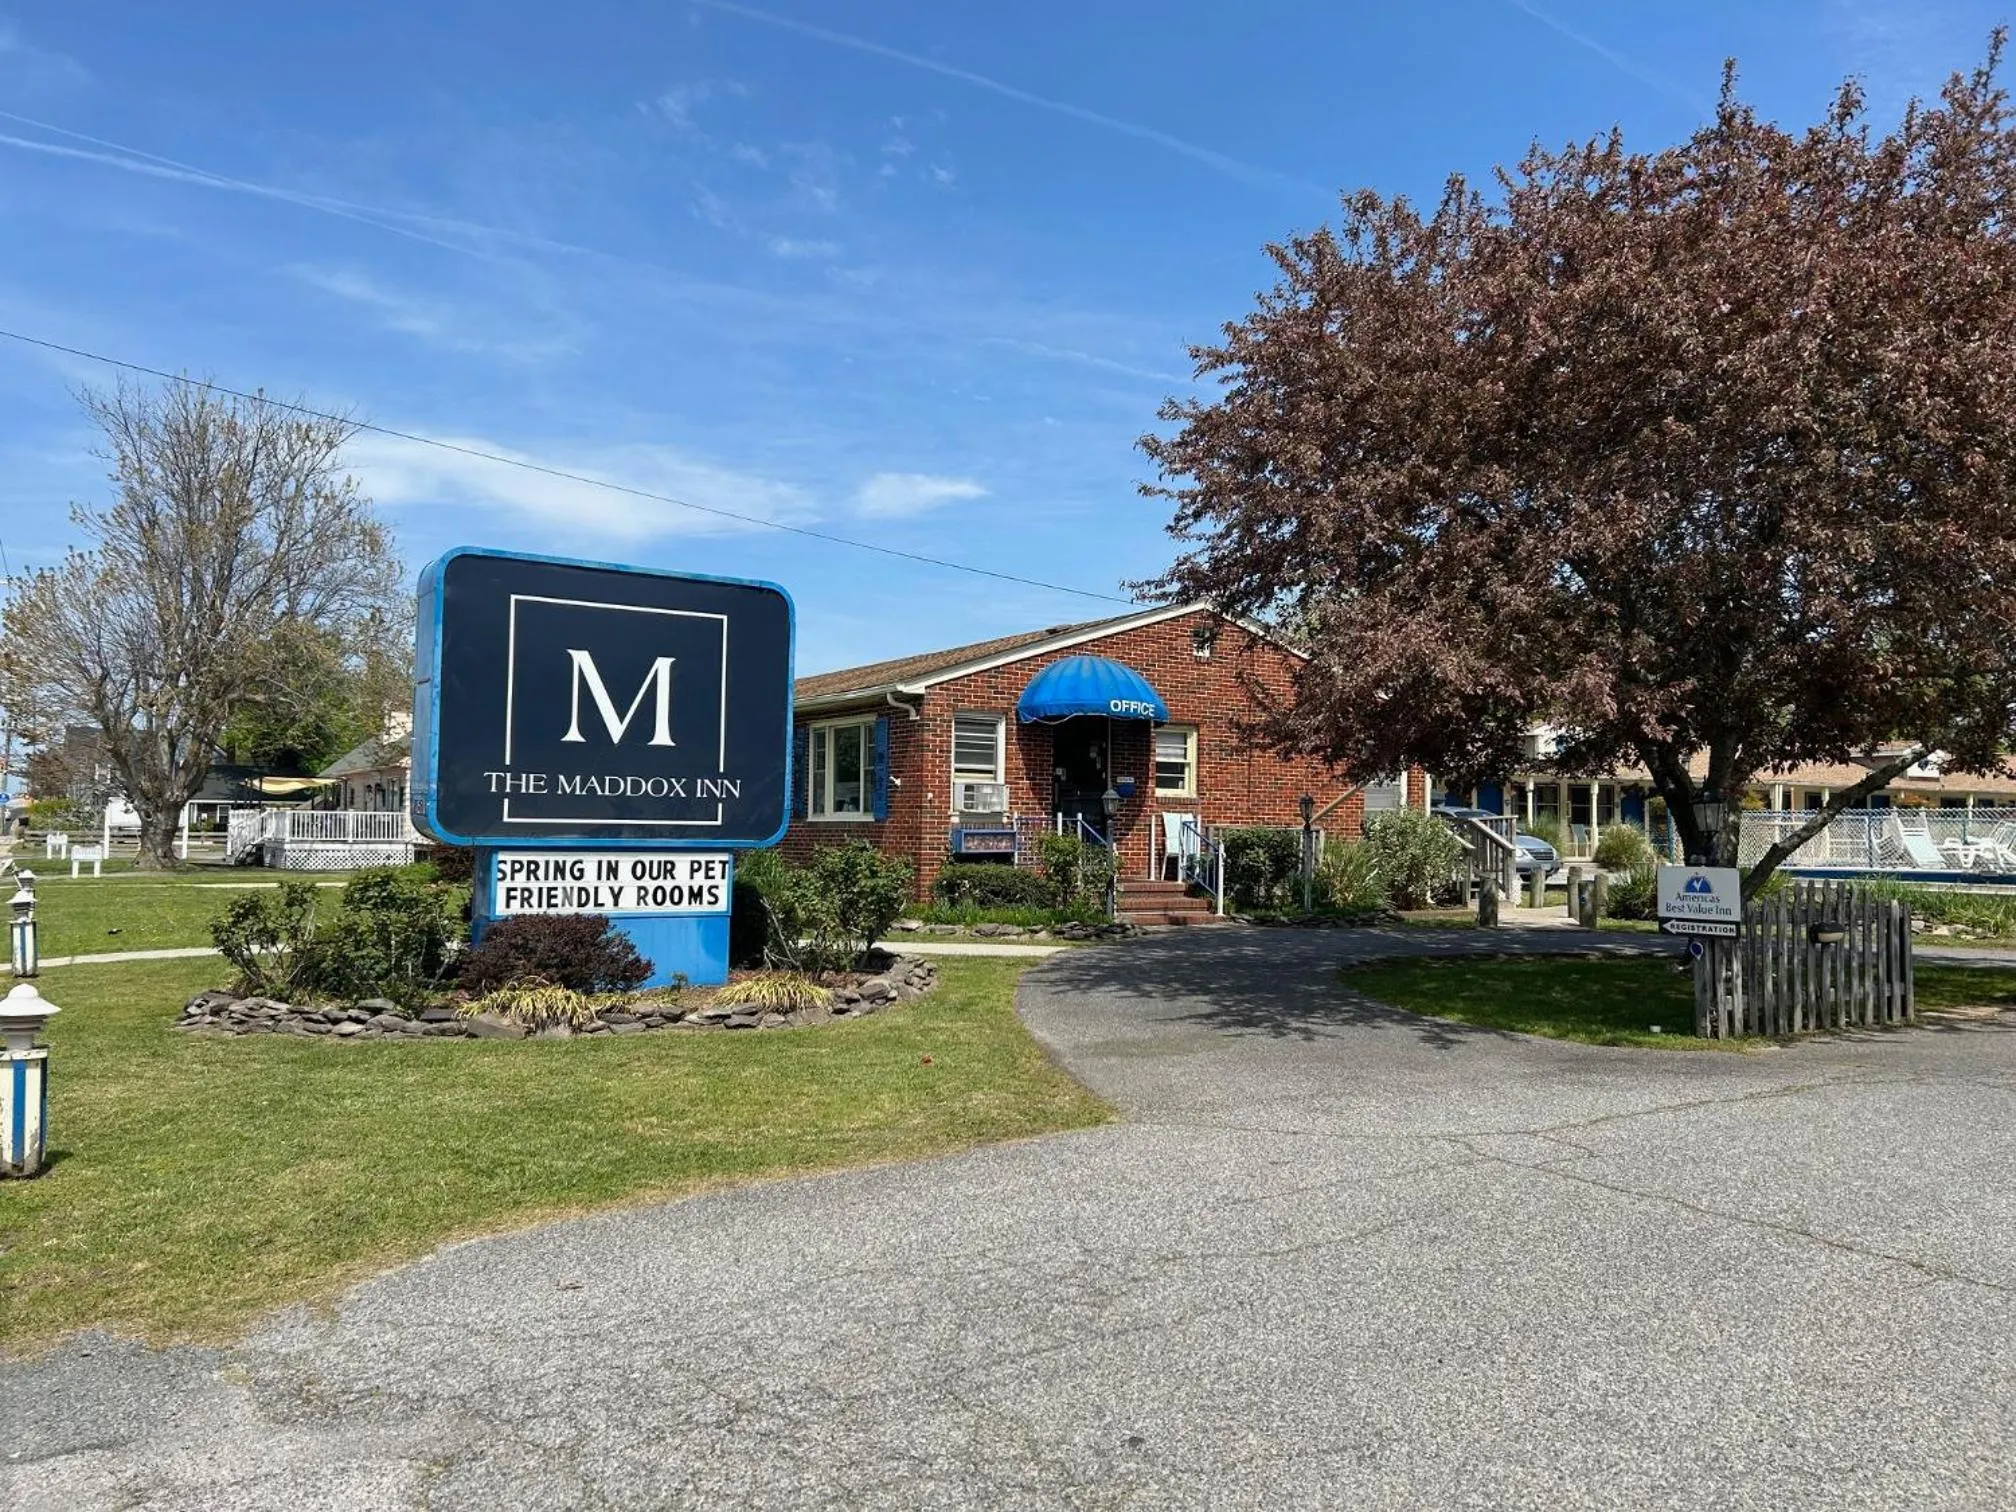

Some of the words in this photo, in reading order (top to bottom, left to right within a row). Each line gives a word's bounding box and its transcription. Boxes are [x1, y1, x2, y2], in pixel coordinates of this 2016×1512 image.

[560, 649, 676, 747] M
[1110, 699, 1155, 717] OFFICE
[483, 772, 548, 794] THE
[557, 774, 687, 798] MADDOX
[695, 778, 741, 799] INN
[497, 859, 585, 881] SPRING
[597, 860, 619, 881] IN
[631, 860, 676, 881] OUR
[689, 860, 729, 881] PET
[505, 886, 624, 909] FRIENDLY
[636, 885, 719, 907] ROOMS
[1675, 892, 1720, 903] Americas
[1666, 902, 1685, 913] Best
[1686, 903, 1713, 915] Value
[1715, 904, 1732, 916] Inn
[1670, 922, 1735, 934] REGISTRATION
